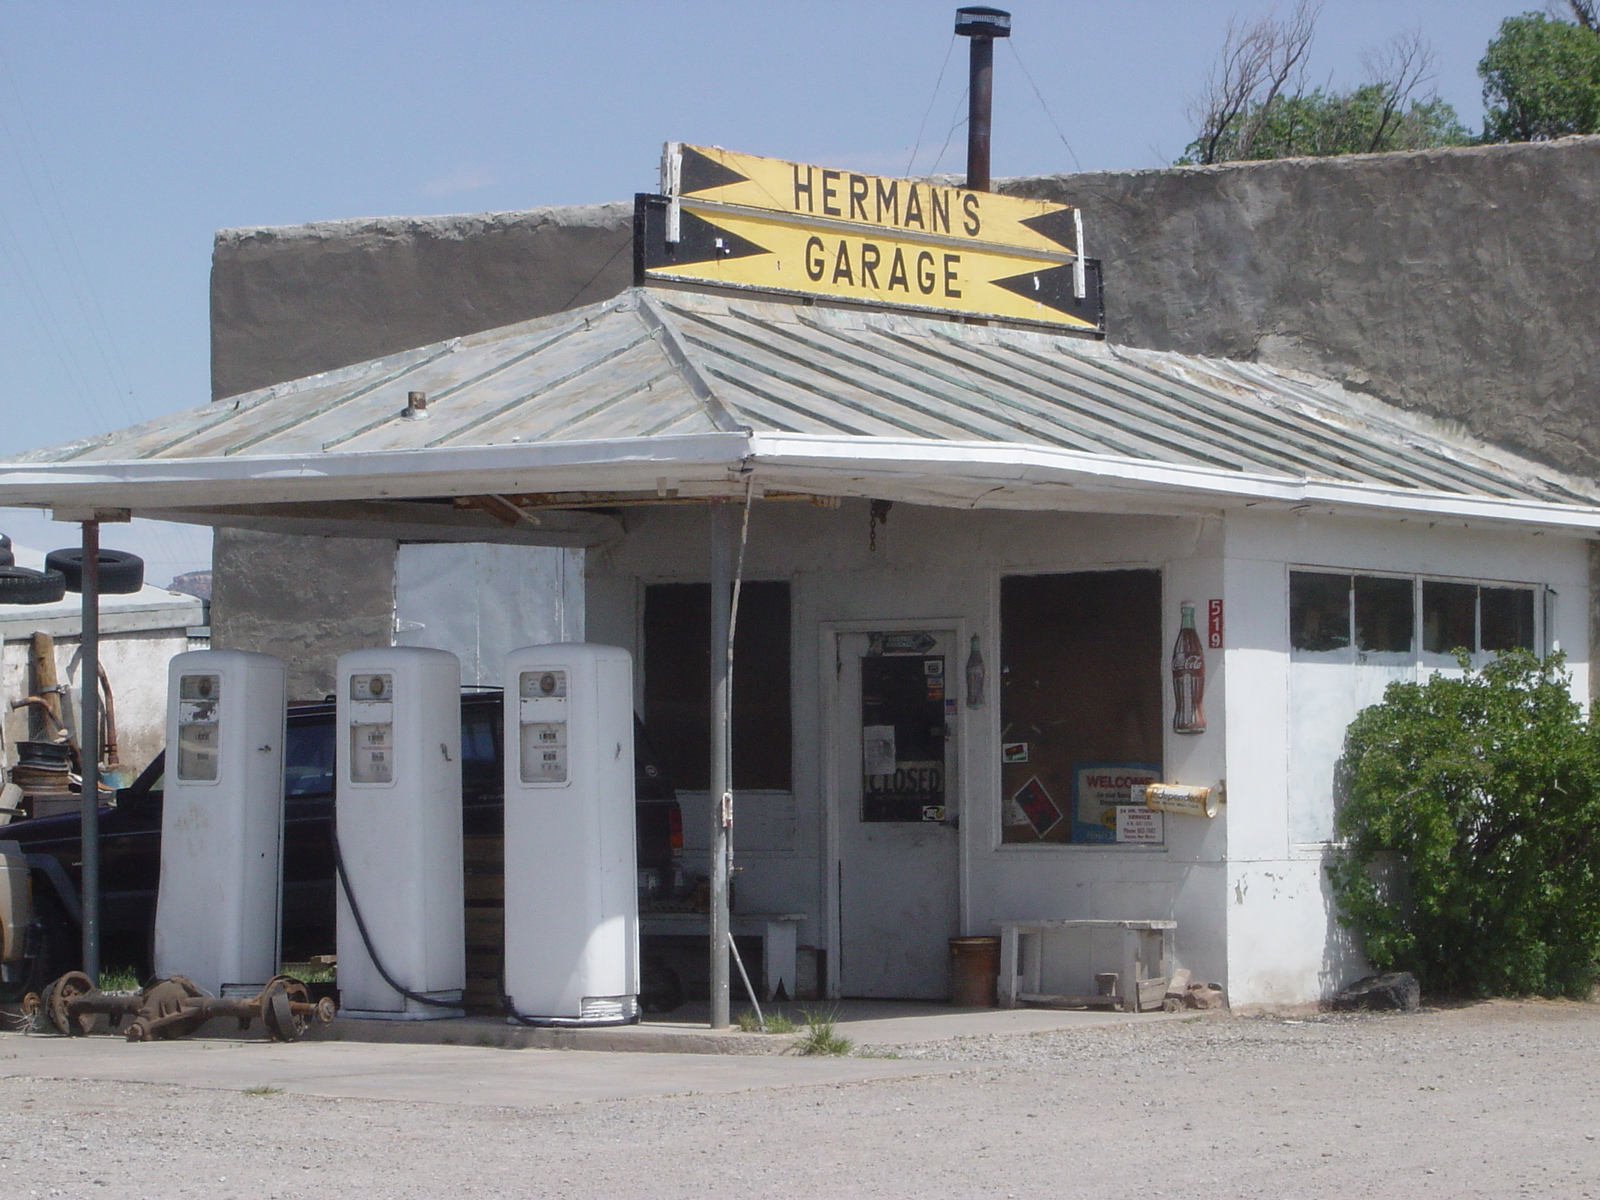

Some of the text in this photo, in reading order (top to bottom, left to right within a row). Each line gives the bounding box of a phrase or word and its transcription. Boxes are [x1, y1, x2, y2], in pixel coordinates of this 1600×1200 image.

[793, 164, 980, 237] HERMAN'S
[805, 236, 962, 299] GARAGE
[1211, 600, 1221, 648] 519
[869, 767, 941, 793] CLOSED
[1086, 775, 1154, 788] WELCOME
[1150, 789, 1203, 803] Independent
